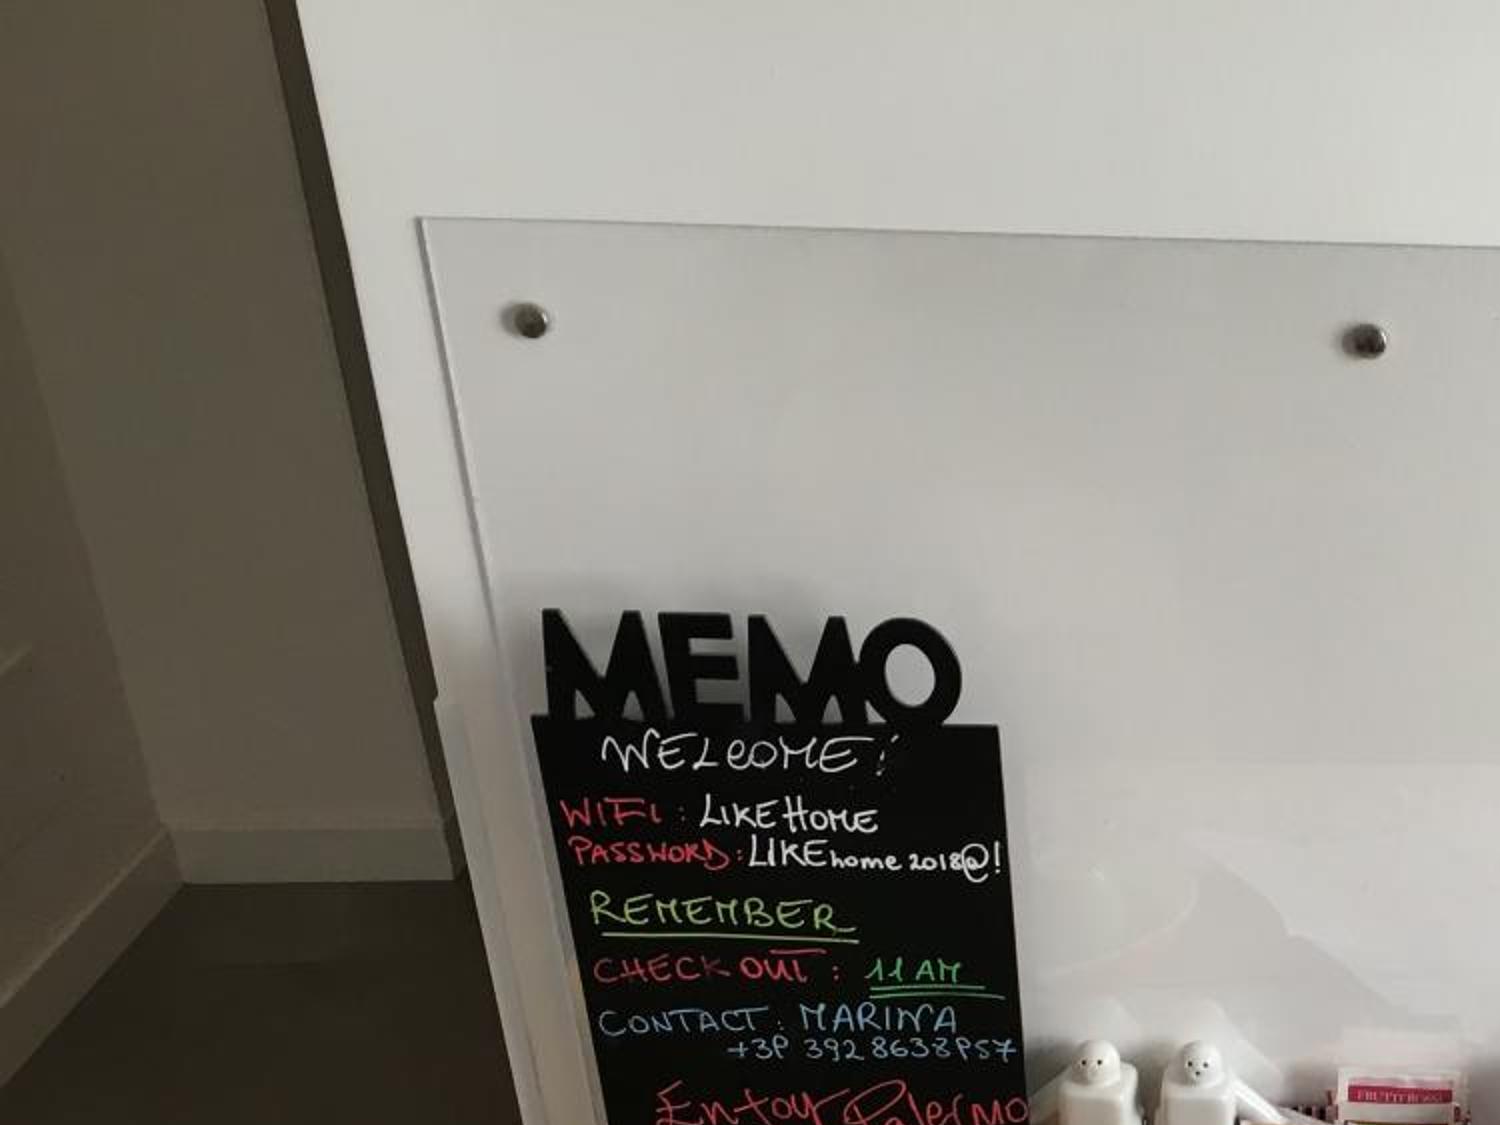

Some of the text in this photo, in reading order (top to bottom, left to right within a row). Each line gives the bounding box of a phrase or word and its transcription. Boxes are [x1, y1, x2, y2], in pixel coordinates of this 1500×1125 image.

[541, 608, 962, 722] MEMO
[591, 890, 858, 934] REMEMBER
[593, 957, 731, 984] CHECK
[914, 958, 963, 984] AM
[799, 1001, 957, 1033] MARINA
[804, 1037, 865, 1062] 392
